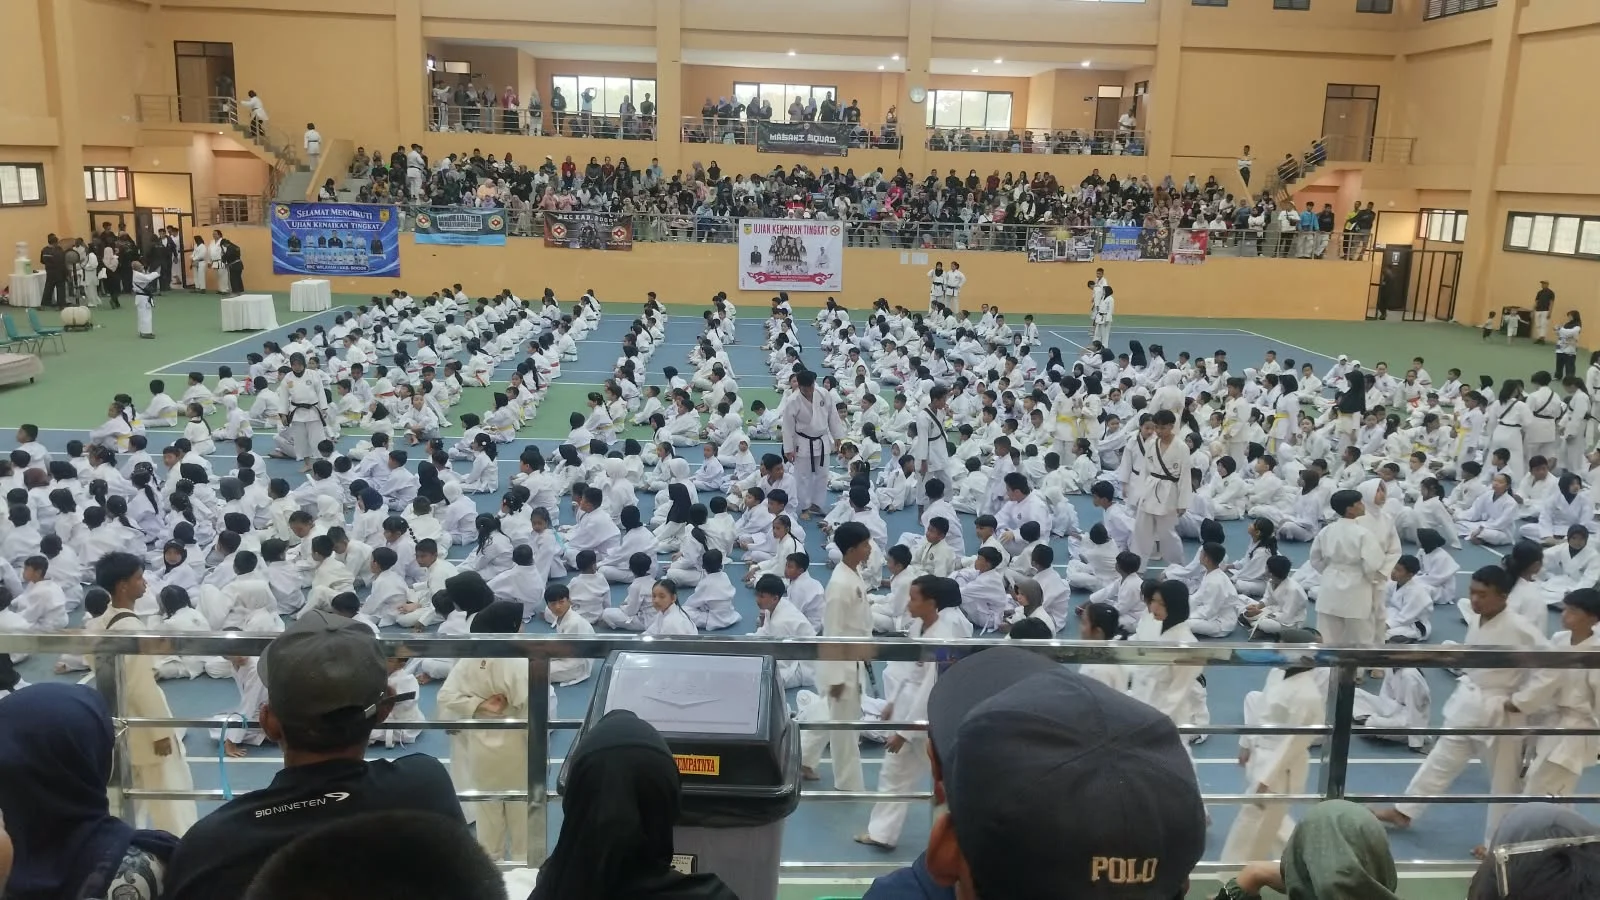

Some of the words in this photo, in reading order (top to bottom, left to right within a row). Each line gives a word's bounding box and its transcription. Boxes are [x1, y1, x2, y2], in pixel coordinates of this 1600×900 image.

[769, 133, 805, 142] MASAKI
[807, 133, 837, 144] SQUAD
[296, 209, 329, 218] SELAMAT
[331, 208, 373, 220] MENGIKUTI
[313, 221, 349, 229] KENAIKAN
[351, 222, 380, 230] TINGKAT
[753, 223, 771, 234] UJIAN
[804, 225, 828, 235] TINGKAT
[674, 757, 715, 772] EMPATNYA
[273, 798, 326, 814] NINETEN
[1091, 856, 1158, 883] POLO
